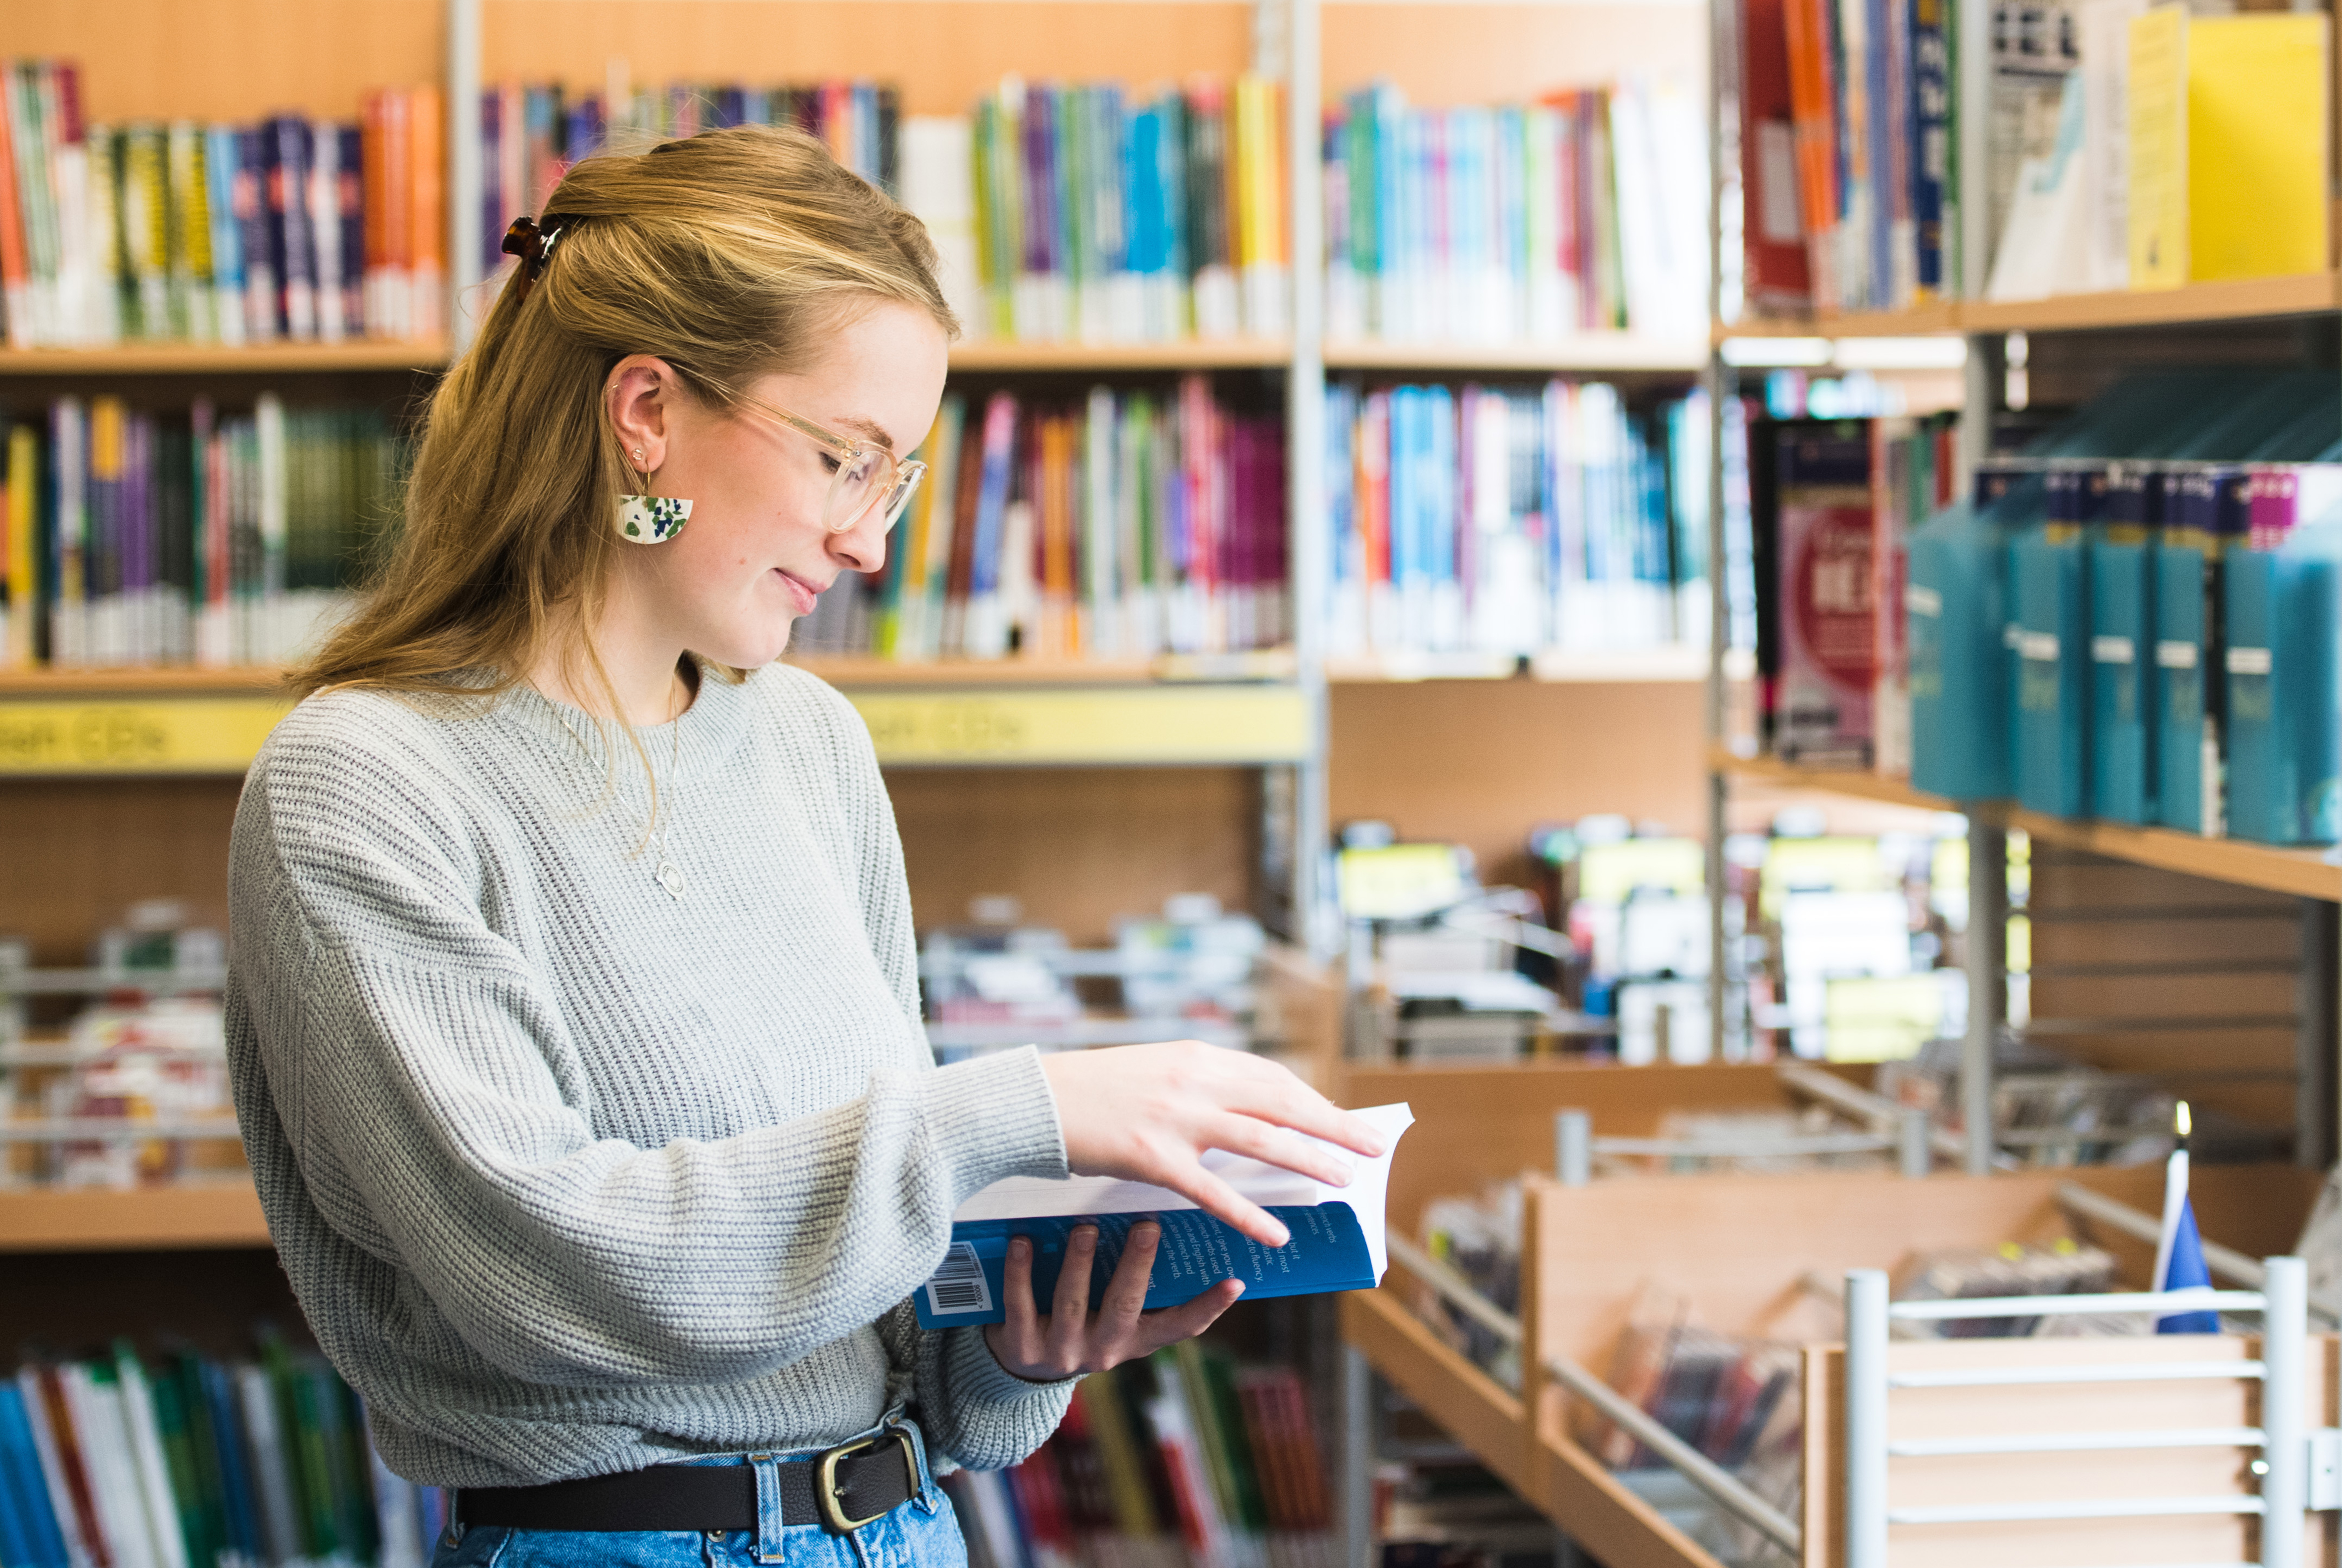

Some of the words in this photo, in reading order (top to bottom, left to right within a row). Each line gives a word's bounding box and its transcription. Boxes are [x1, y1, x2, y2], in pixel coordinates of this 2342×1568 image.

[1319, 1212, 1331, 1227] French
[1326, 1227, 1336, 1243] verbs
[1187, 1233, 1199, 1244] and
[1216, 1238, 1227, 1251] give
[1177, 1240, 1190, 1260] French
[1192, 1244, 1206, 1267] English
[1198, 1223, 1209, 1239] French
[1205, 1239, 1215, 1256] verbs
[1210, 1257, 1222, 1274] used
[1262, 1244, 1273, 1266] ntastic
[1288, 1242, 1298, 1253] but
[1162, 1239, 1171, 1249] use
[1167, 1250, 1175, 1260] the
[1171, 1262, 1182, 1280] verb.
[1222, 1252, 1231, 1265] you
[1279, 1255, 1290, 1273] most
[1183, 1261, 1195, 1275] and
[1226, 1267, 1236, 1279] ove
[1251, 1254, 1263, 1283] fluency.
[1200, 1269, 1211, 1285] with
[974, 1285, 983, 1302] 90000
